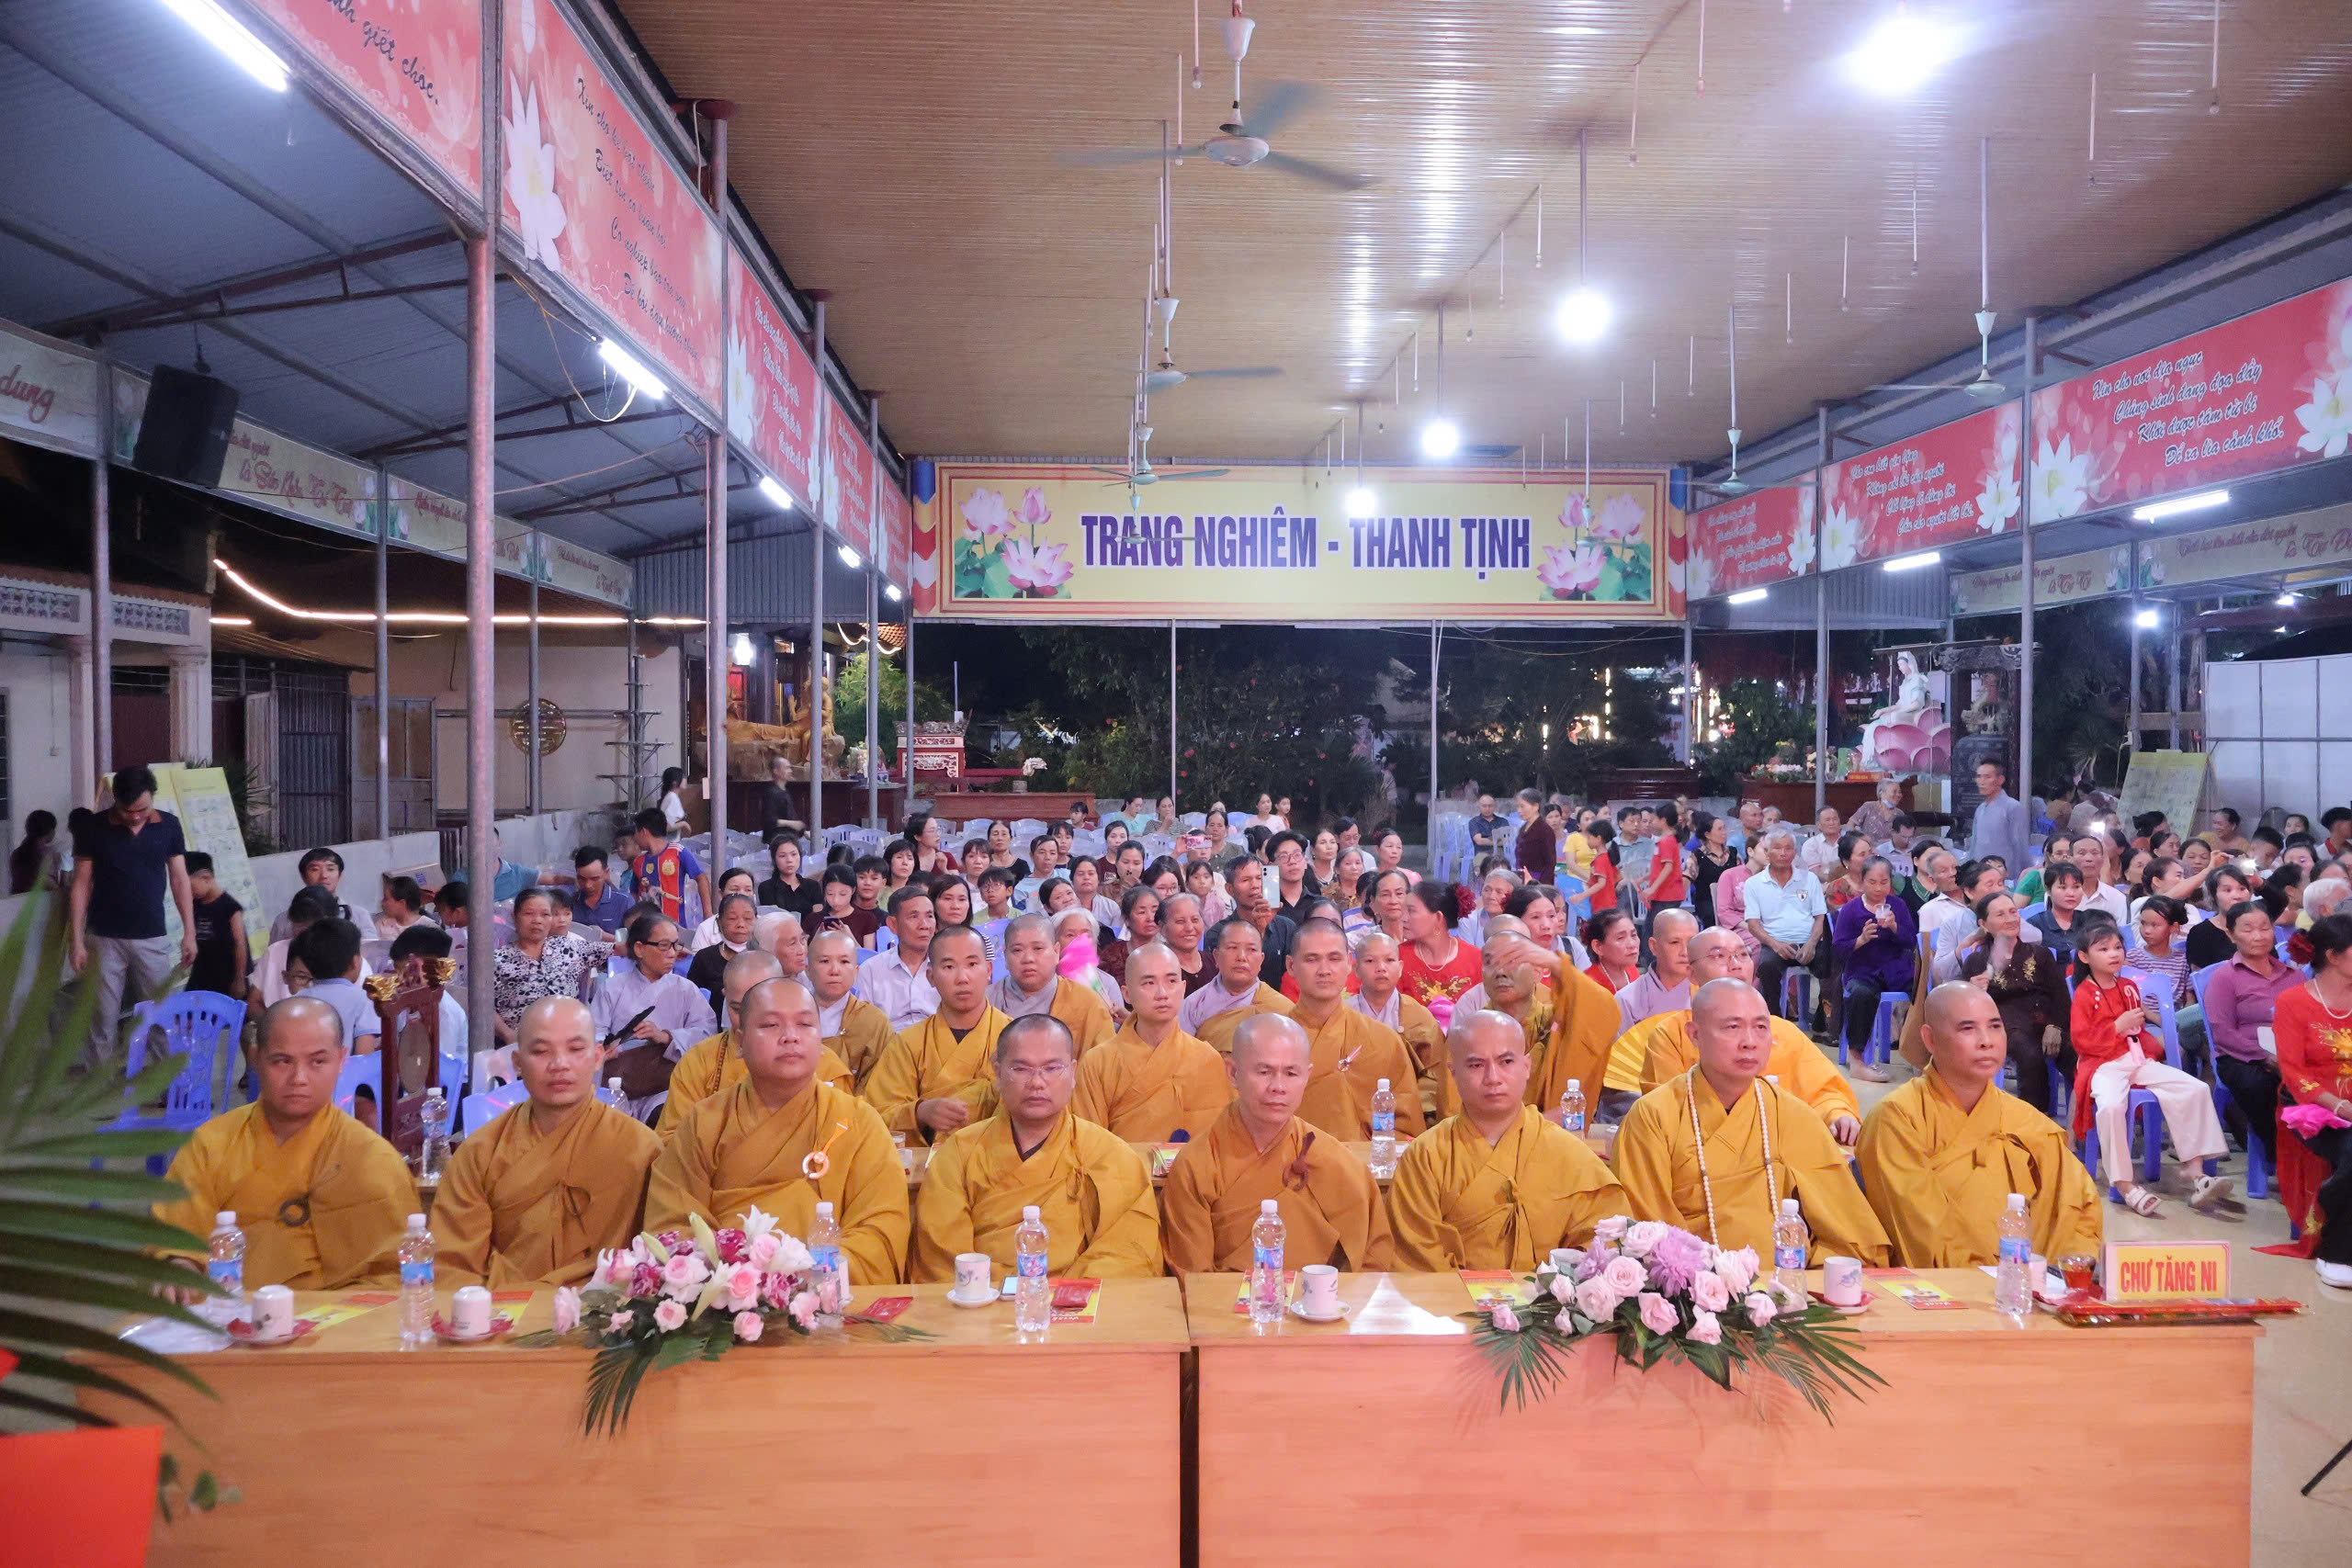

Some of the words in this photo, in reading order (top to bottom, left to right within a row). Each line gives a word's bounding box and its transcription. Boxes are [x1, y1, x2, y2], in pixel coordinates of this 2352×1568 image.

[362, 20, 395, 62] giết
[577, 78, 594, 116] Xin
[596, 111, 609, 135] cho
[595, 148, 613, 186] Biết
[2092, 378, 2112, 401] Xin
[2114, 370, 2132, 393] cho
[2133, 367, 2152, 387] nơi
[2154, 359, 2173, 382] địa
[2175, 351, 2203, 376] ngục
[2114, 399, 2149, 424] Chúng
[2150, 384, 2175, 411] sinh
[2177, 381, 2207, 402] đang
[2209, 371, 2233, 395] đọa
[2138, 419, 2166, 445] Khởi
[2197, 407, 2222, 428] tâm
[2224, 397, 2243, 421] từ
[2243, 391, 2258, 415] bi
[2165, 442, 2186, 467] Để
[2184, 446, 2199, 462] xa
[2222, 424, 2254, 453] cảnh
[2256, 414, 2285, 445] khổ.
[1081, 515, 1184, 568] TRANG
[1193, 505, 1317, 569] NGHIÊM
[1349, 517, 1451, 568] THANH
[1460, 518, 1531, 580] TỊNH
[2120, 1258, 2154, 1293] CHƯ
[2155, 1255, 2196, 1292] TĂNG
[2200, 1260, 2217, 1292] NI
